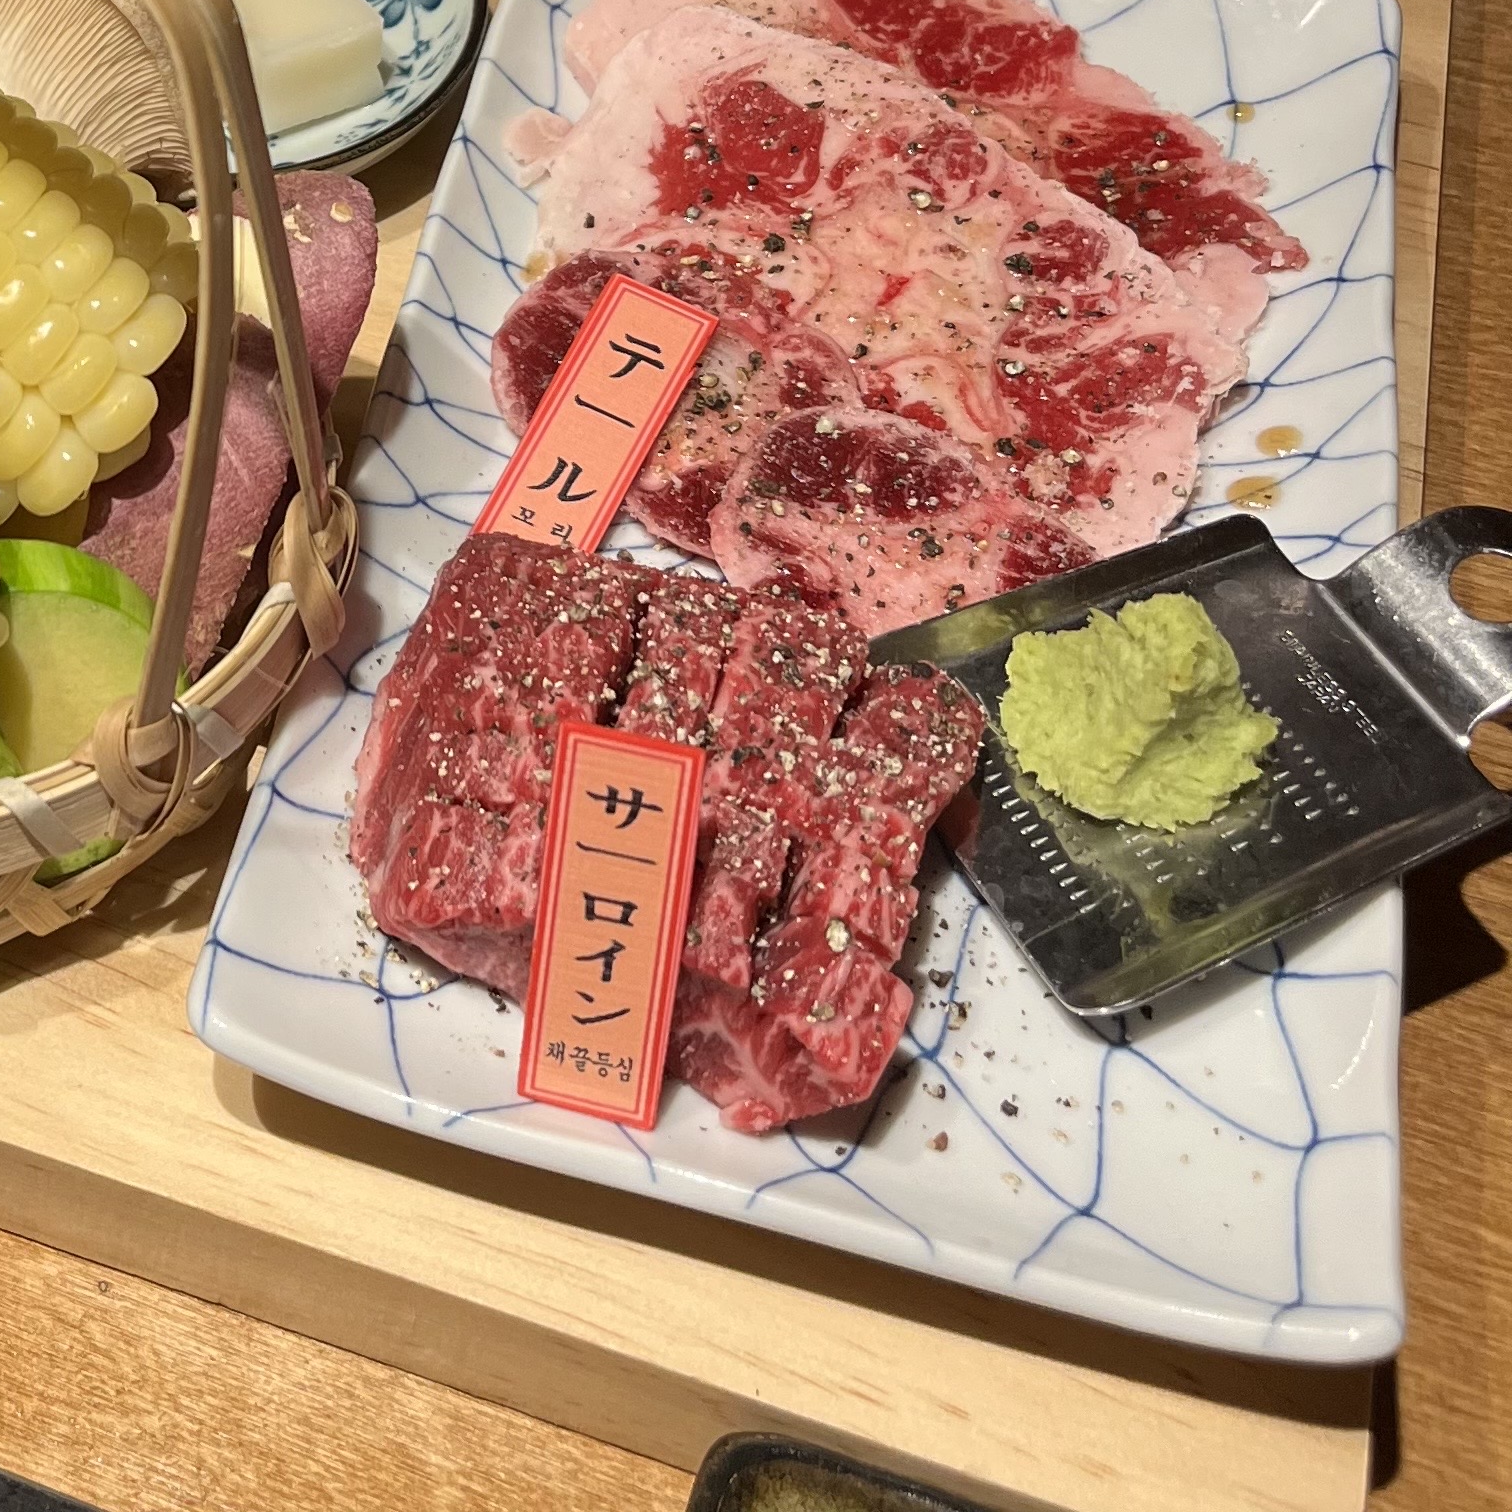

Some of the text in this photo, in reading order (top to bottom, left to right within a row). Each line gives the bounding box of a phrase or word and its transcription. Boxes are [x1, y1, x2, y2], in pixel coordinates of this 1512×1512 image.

[526, 333, 665, 502] テール
[571, 784, 664, 1026] サーロイン
